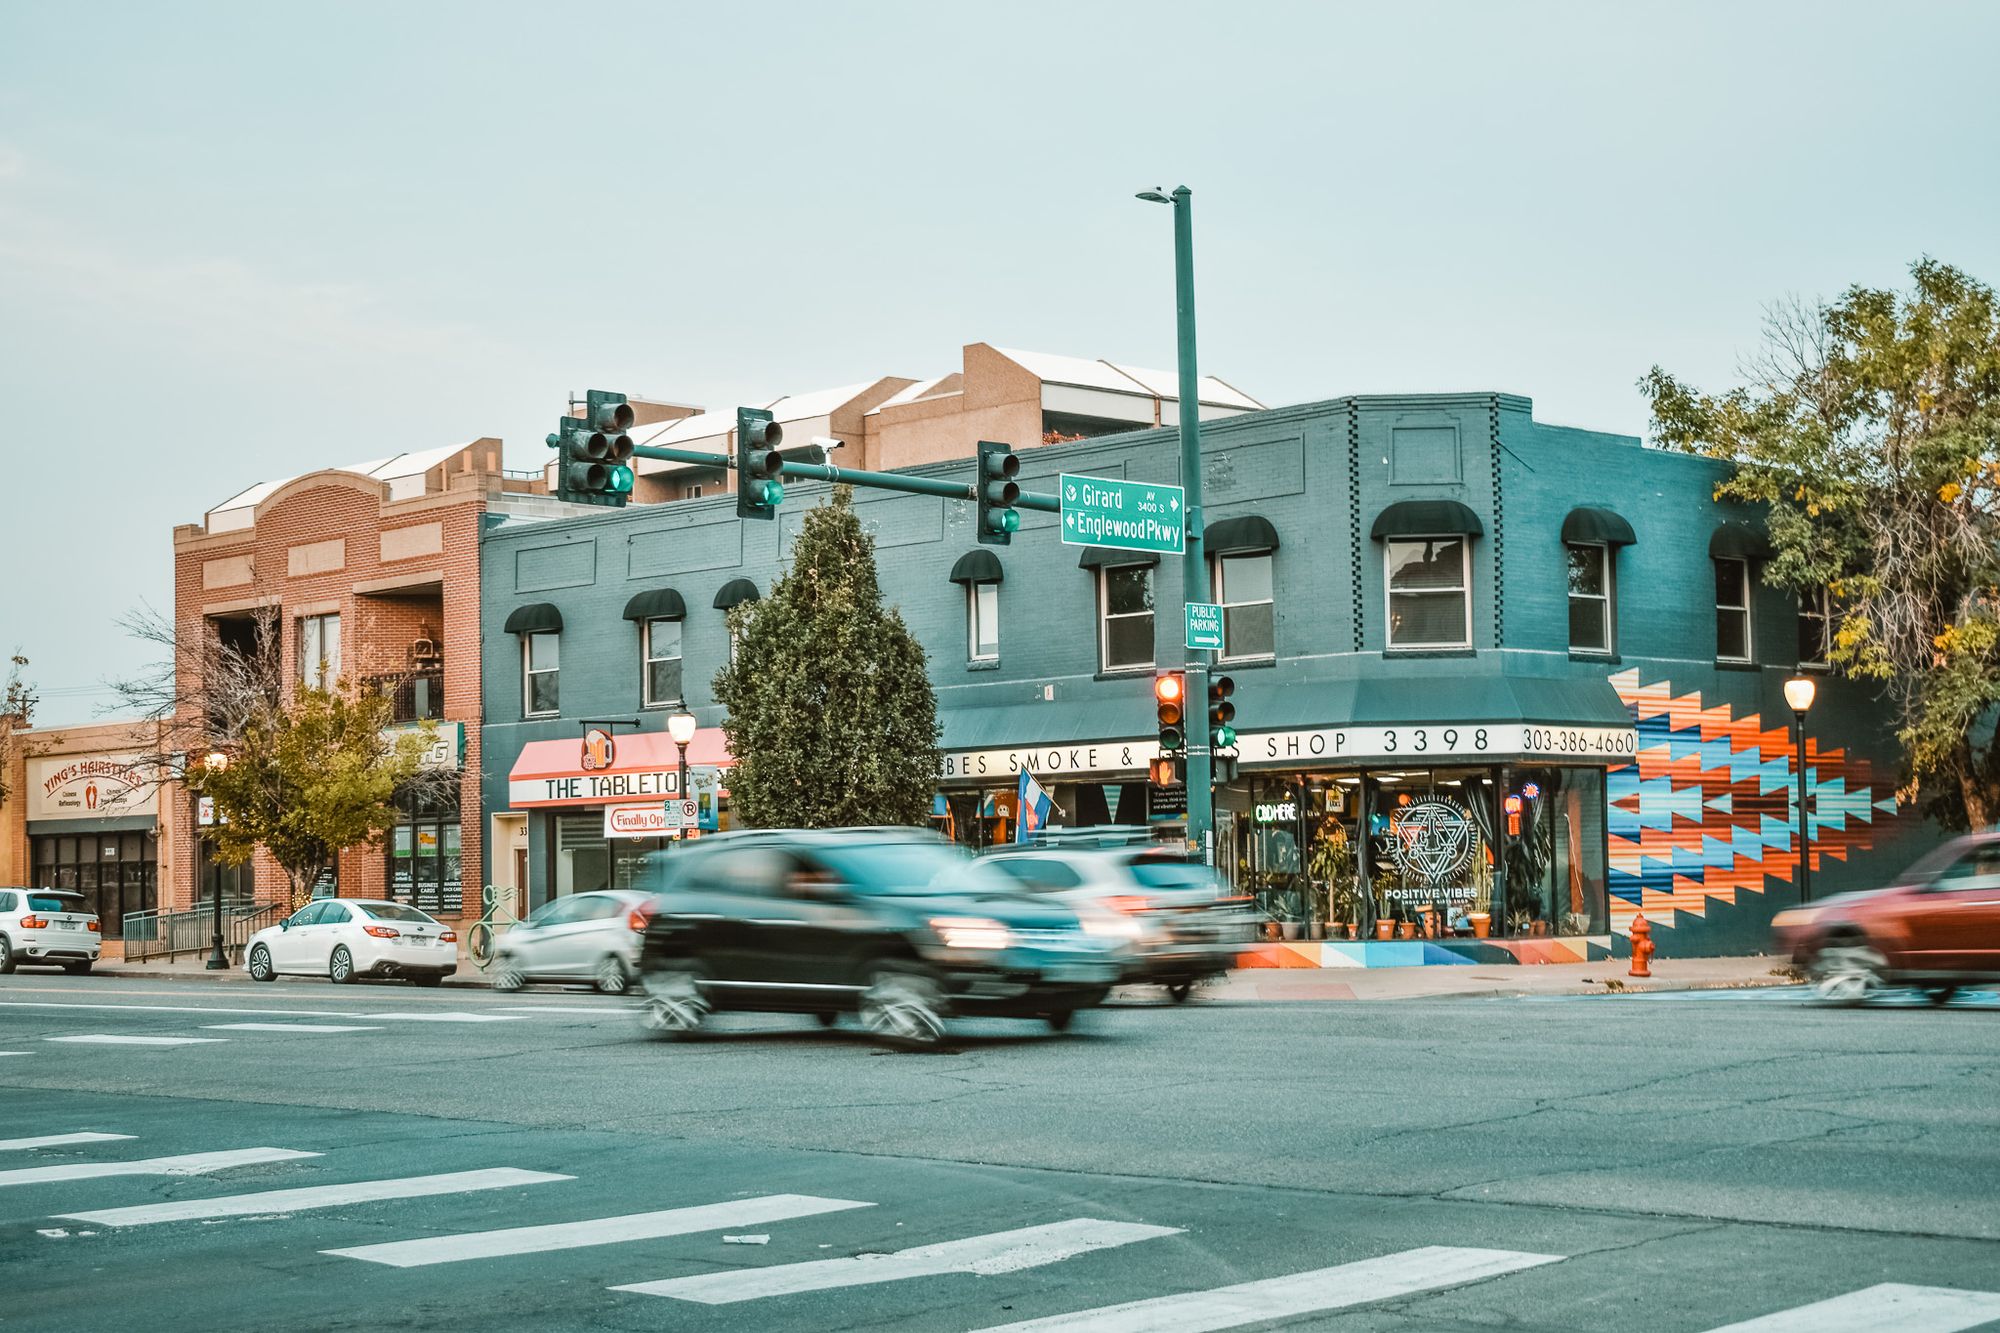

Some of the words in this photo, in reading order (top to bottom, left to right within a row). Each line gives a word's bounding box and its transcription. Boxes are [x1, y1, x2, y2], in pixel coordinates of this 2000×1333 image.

[1082, 484, 1123, 509] Girard
[1146, 492, 1155, 501] AV
[1137, 502, 1157, 513] 3400
[1159, 504, 1165, 513] S
[1077, 512, 1145, 541] Englewood
[1147, 520, 1180, 547] Pkwy
[1191, 606, 1217, 618] PUBLIC
[1190, 619, 1219, 632] PARKING
[1523, 729, 1634, 753] 303-386-4660
[1009, 748, 1097, 772] SMOKE
[1121, 746, 1133, 766] &
[1267, 733, 1346, 757] SHOP
[1384, 729, 1488, 752] 3398
[44, 764, 77, 793] YING'S
[545, 777, 582, 799] THE
[616, 814, 648, 827] Finally
[649, 813, 665, 827] Op
[1273, 803, 1297, 821] HERE
[1384, 888, 1440, 899] POSITIVE
[1442, 887, 1478, 898] VIBES
